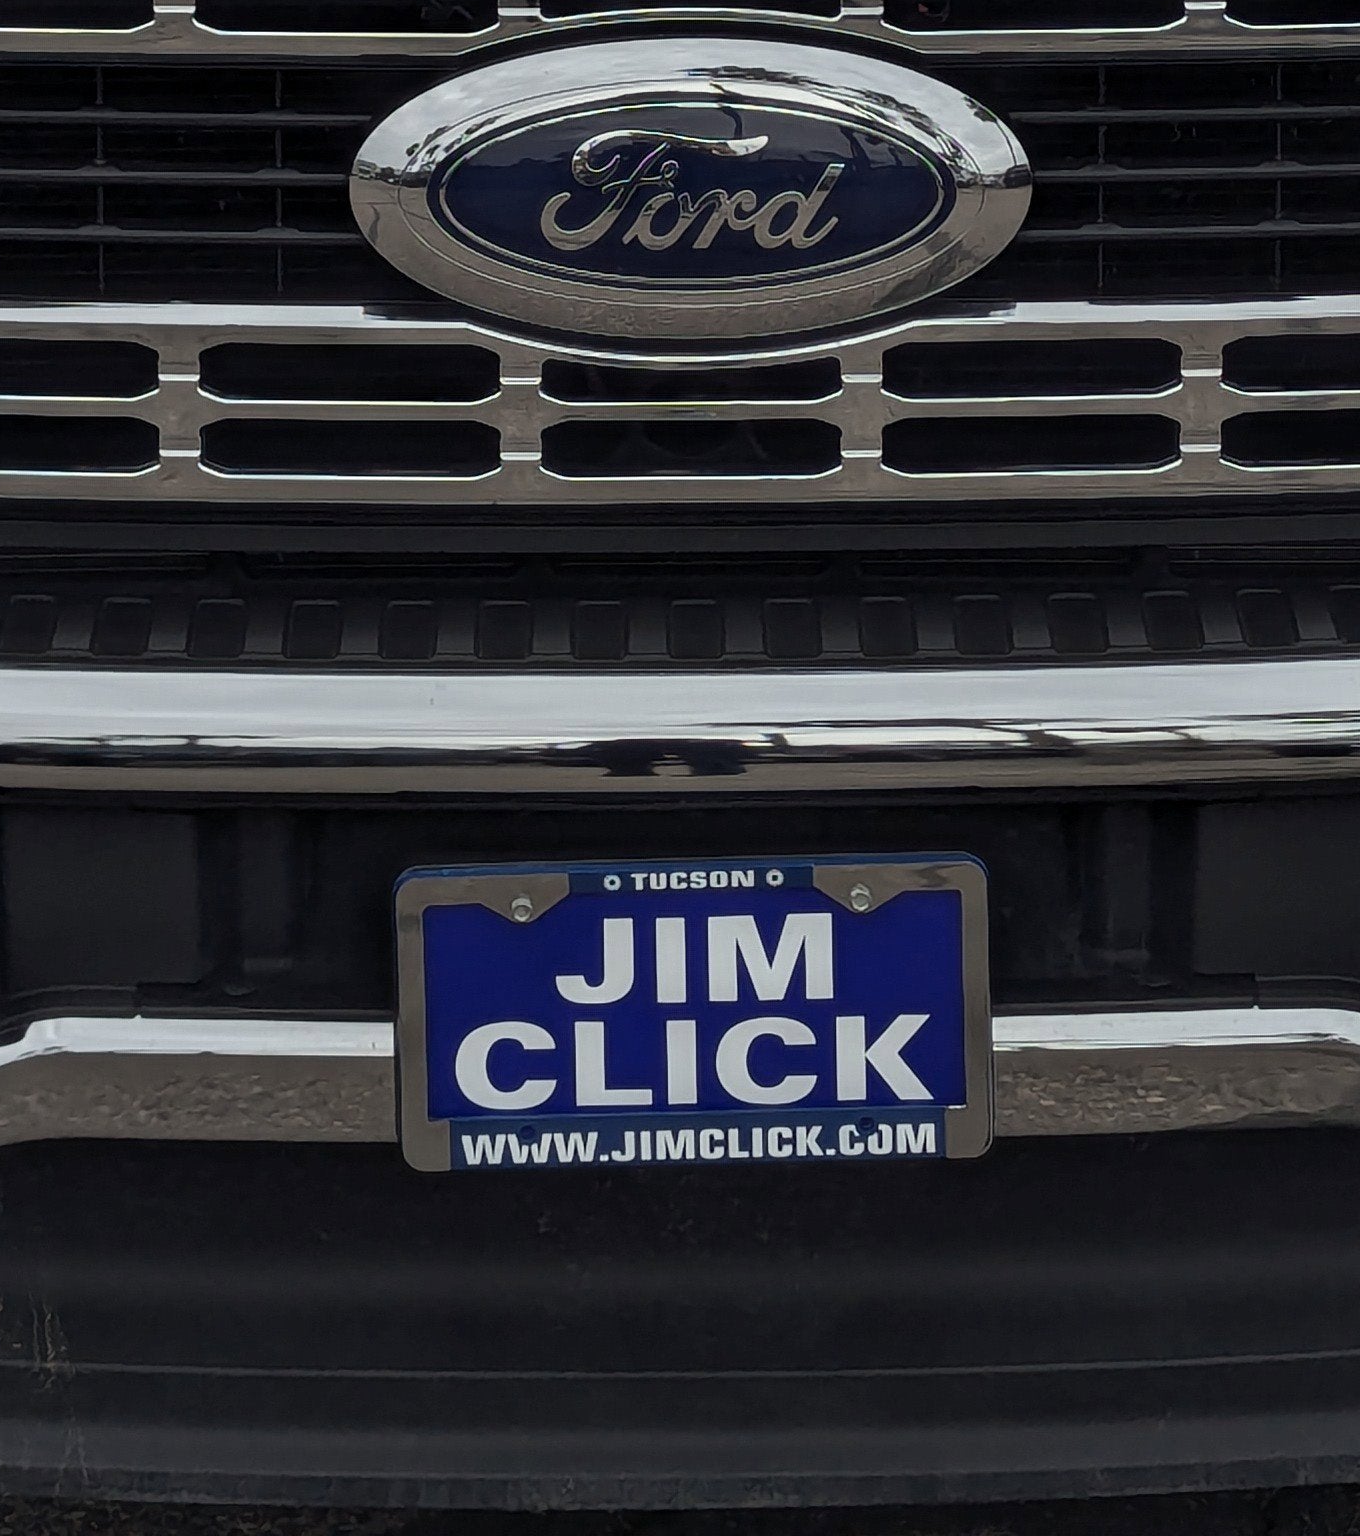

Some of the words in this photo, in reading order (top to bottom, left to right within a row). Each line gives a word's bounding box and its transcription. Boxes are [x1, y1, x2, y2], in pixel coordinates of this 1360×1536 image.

[540, 128, 845, 251] Ford
[630, 868, 756, 891] TUCSON
[554, 911, 835, 1005] JIM
[454, 1012, 935, 1111] CLICK
[461, 1122, 937, 1166] WWW.JIMCLICK.COM
